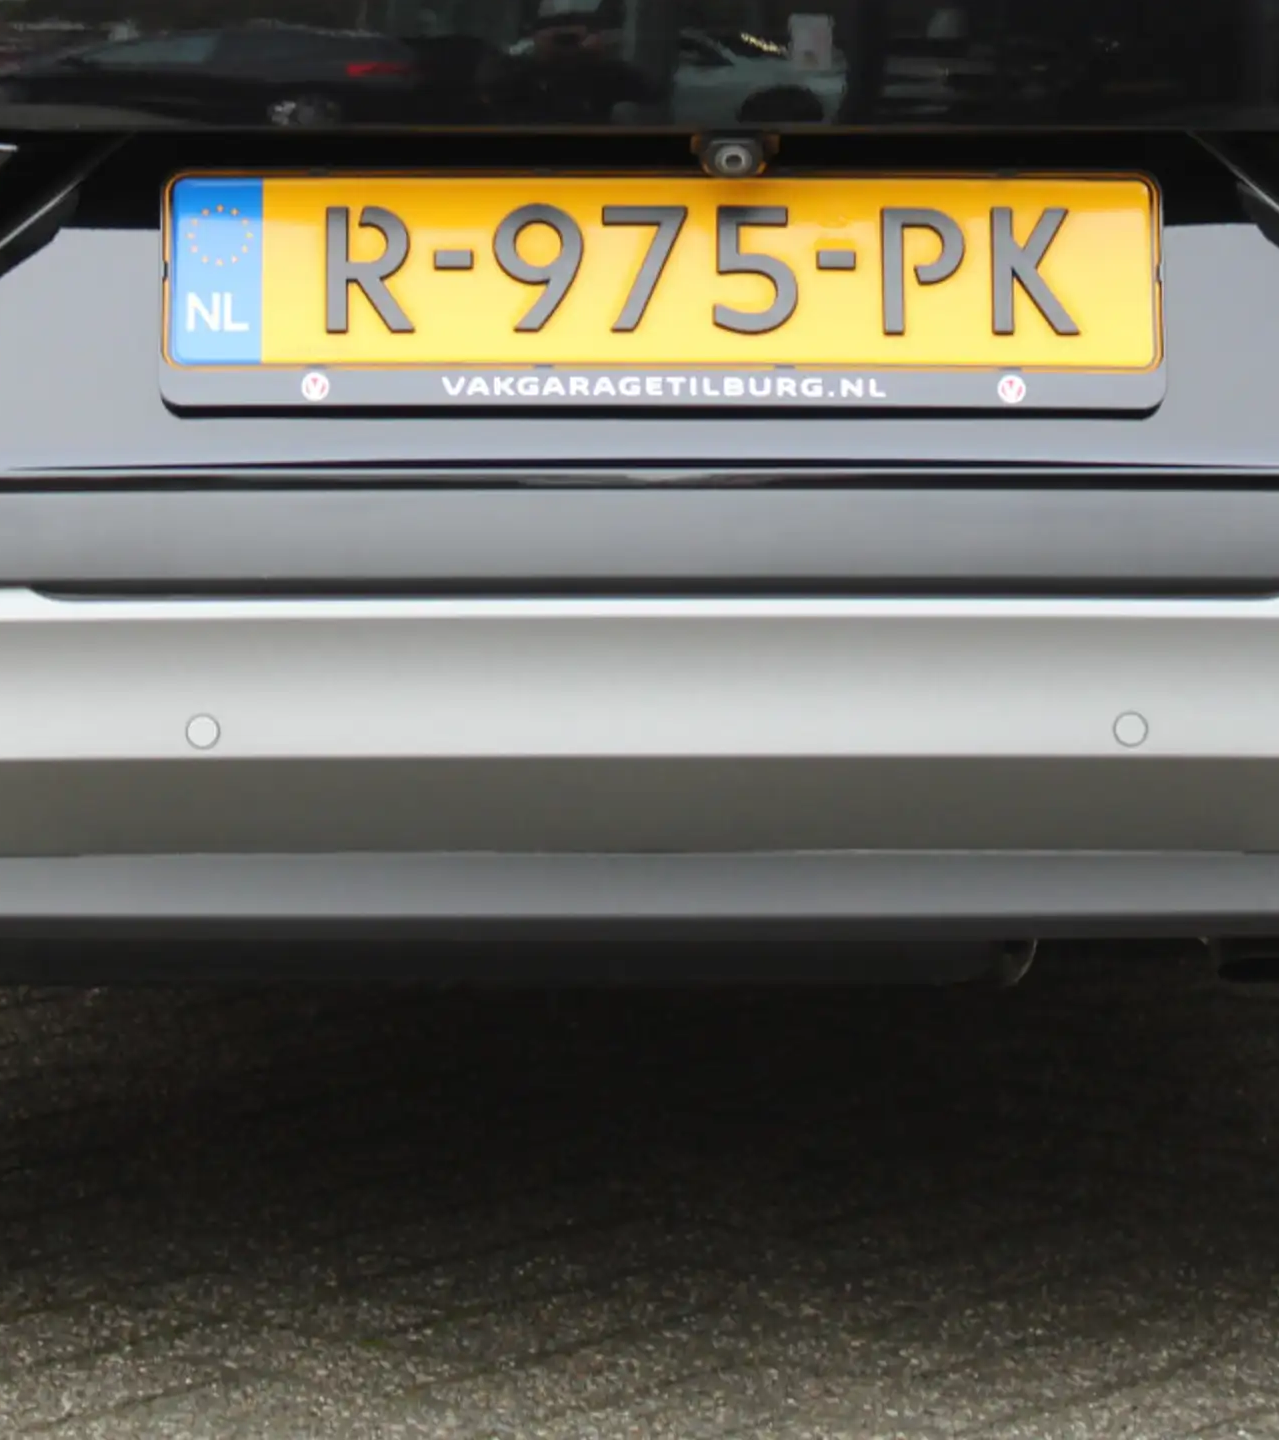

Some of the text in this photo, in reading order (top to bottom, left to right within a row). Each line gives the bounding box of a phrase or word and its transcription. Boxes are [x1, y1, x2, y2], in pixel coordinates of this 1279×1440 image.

[185, 204, 1081, 336] NL R-975-PK
[439, 374, 888, 400] VAKGARAGETILBURG.NL
